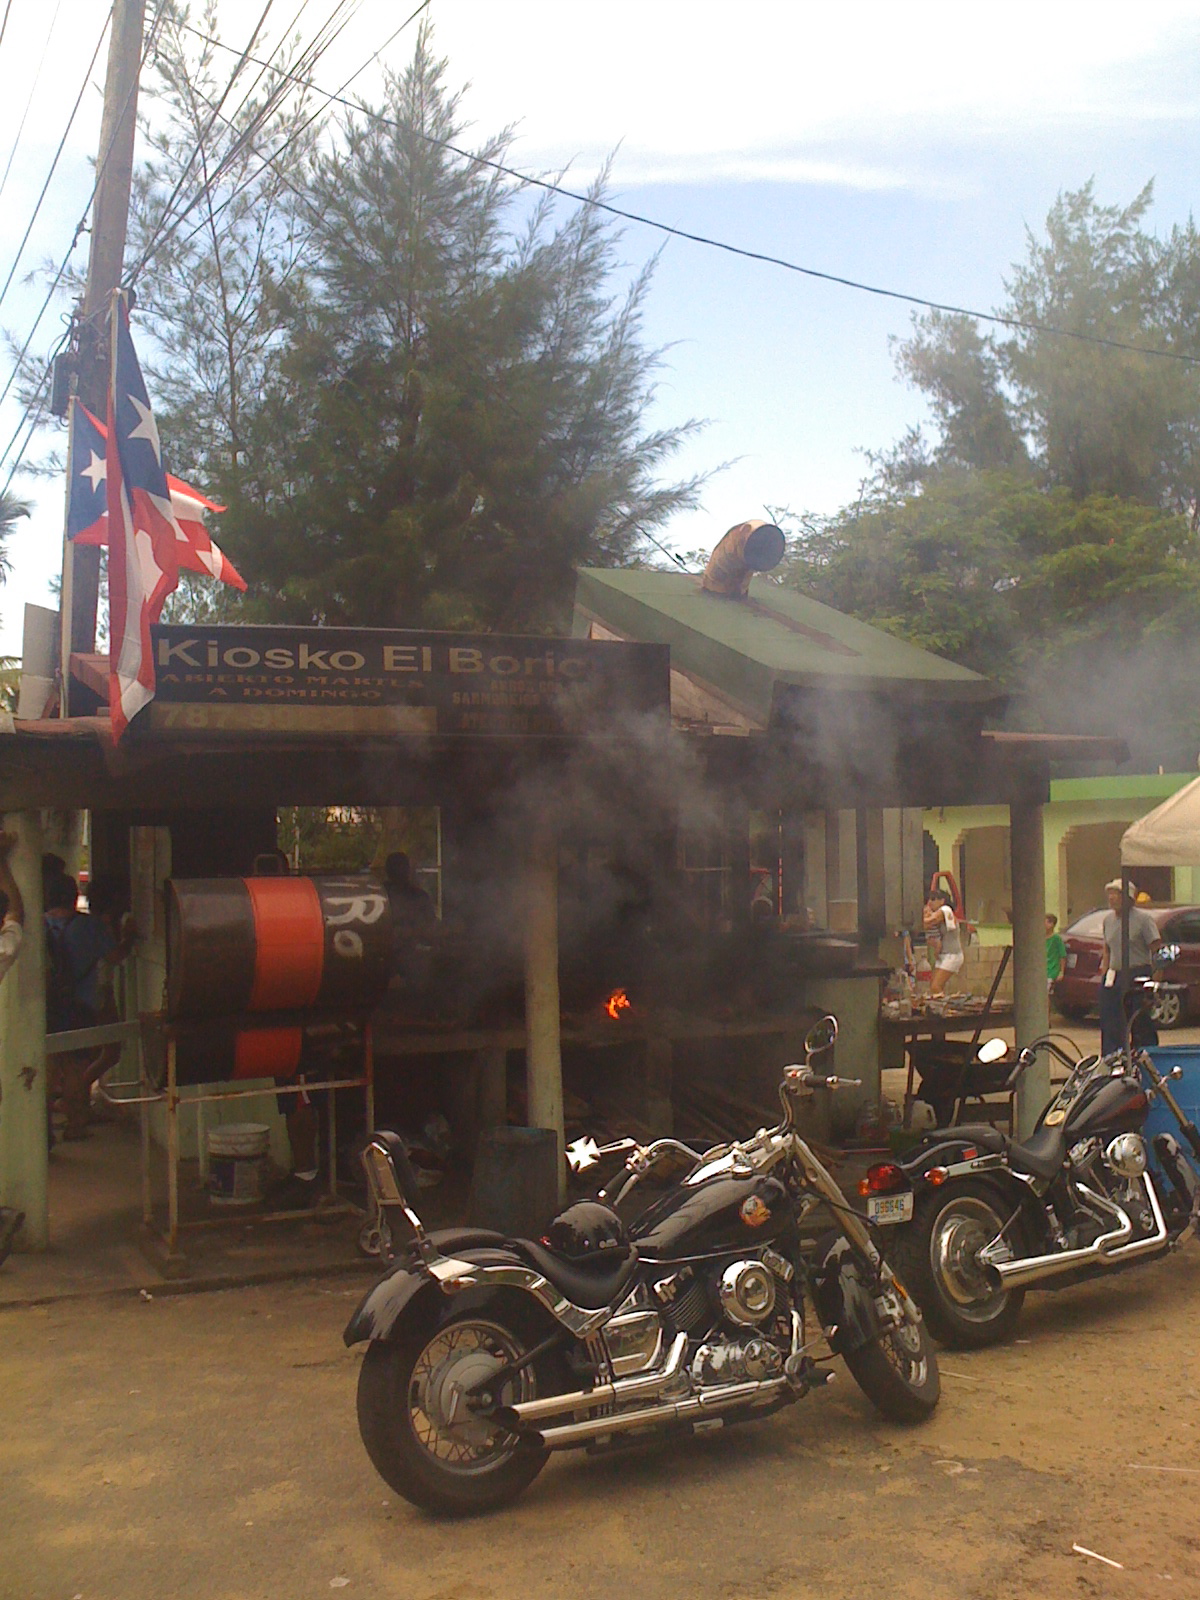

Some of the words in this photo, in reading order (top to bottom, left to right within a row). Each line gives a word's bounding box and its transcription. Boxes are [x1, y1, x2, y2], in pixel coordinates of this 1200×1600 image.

[157, 638, 366, 671] Kiosko
[383, 645, 432, 672] El
[160, 673, 295, 685] ABIERTO
[208, 687, 228, 697] A
[242, 687, 382, 699] DOMINGO
